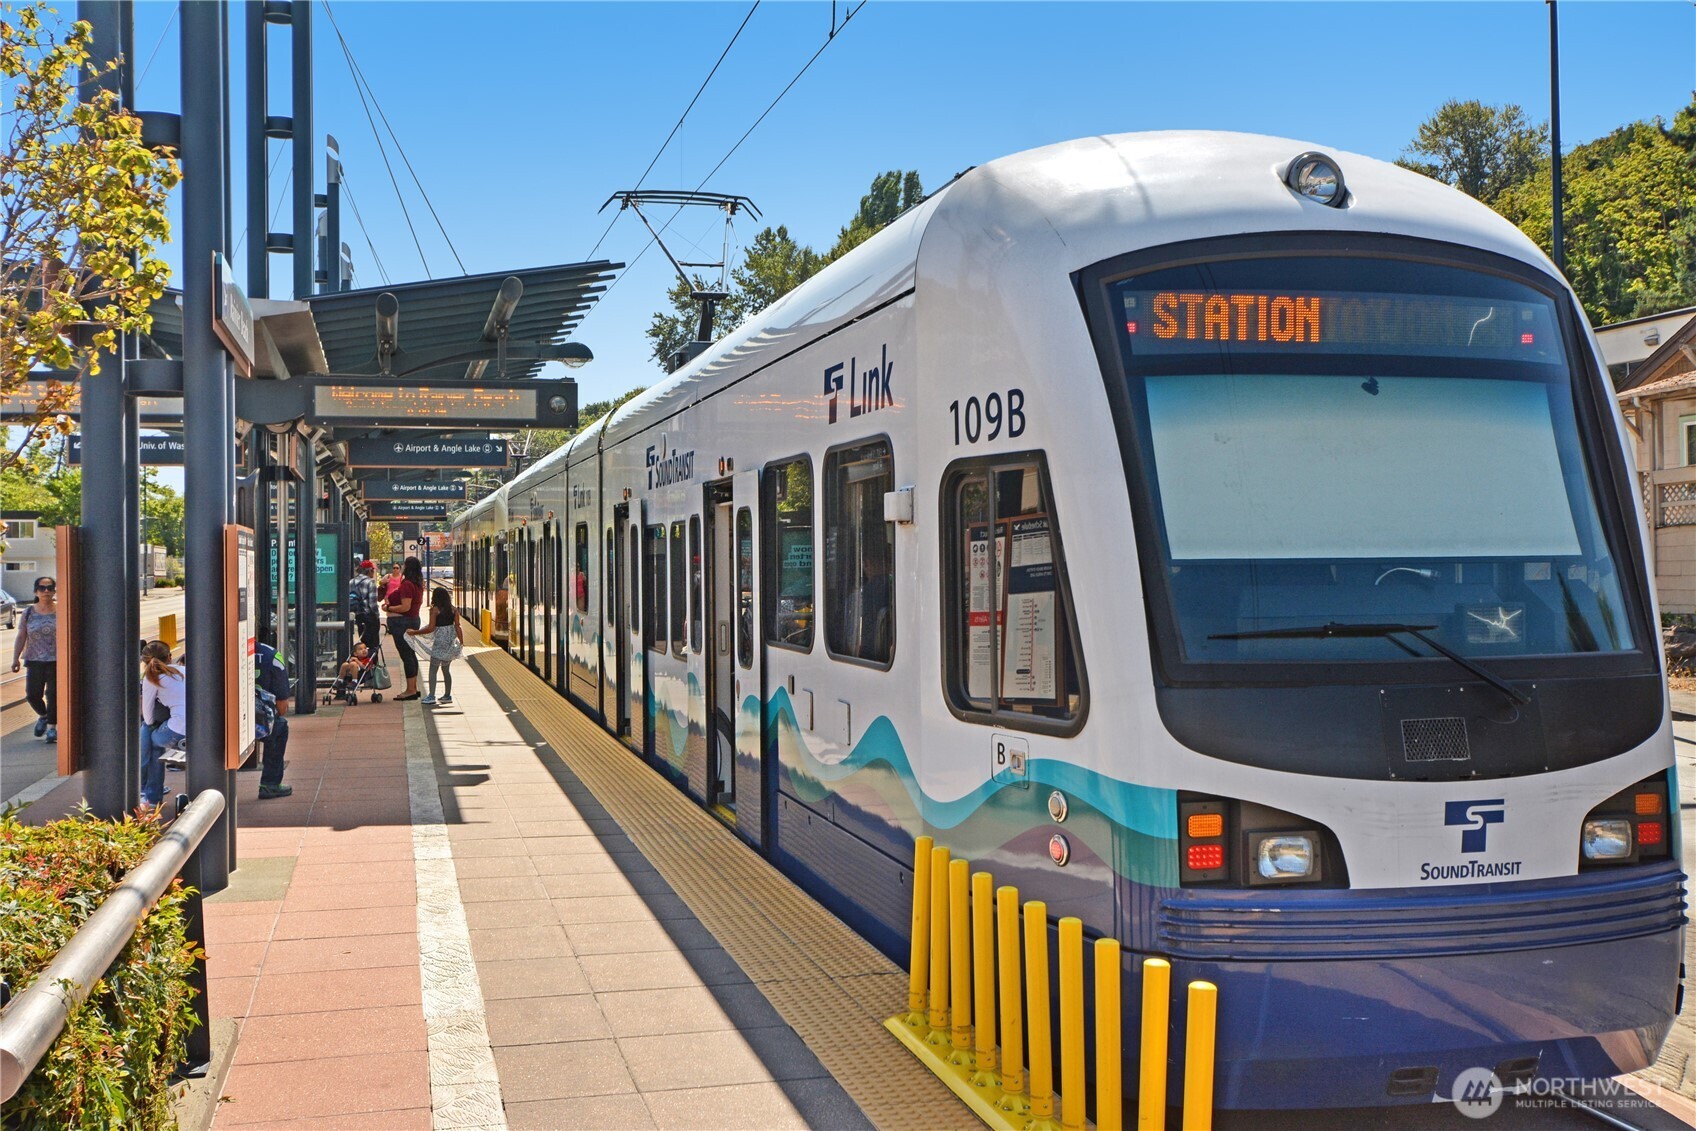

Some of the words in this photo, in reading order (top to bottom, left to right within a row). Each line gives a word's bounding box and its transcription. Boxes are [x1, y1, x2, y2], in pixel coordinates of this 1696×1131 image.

[1152, 293, 1320, 343] STATION
[850, 343, 894, 418] Link
[949, 388, 1026, 446] 109B
[157, 440, 167, 450] of
[405, 444, 432, 454] Airport
[433, 444, 439, 452] &
[441, 444, 463, 454] Angle
[464, 444, 481, 453] Lake
[997, 742, 1006, 765] B
